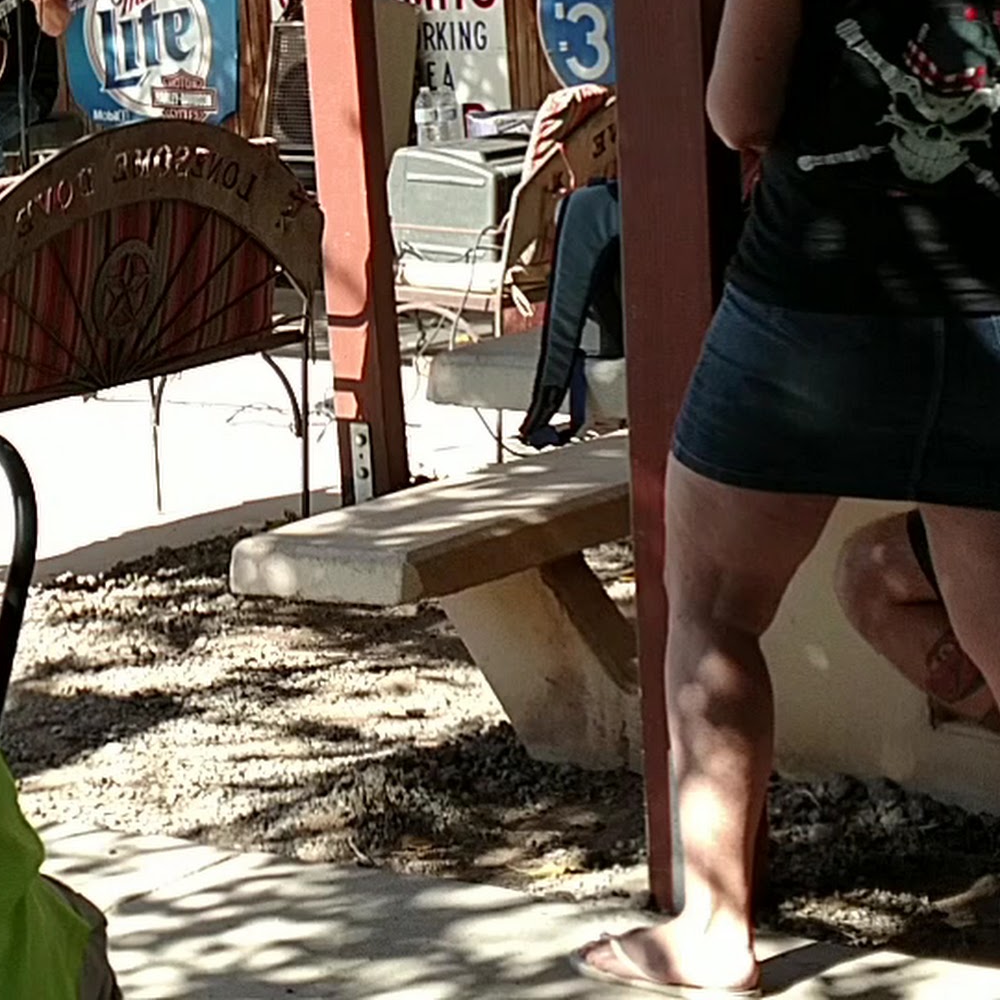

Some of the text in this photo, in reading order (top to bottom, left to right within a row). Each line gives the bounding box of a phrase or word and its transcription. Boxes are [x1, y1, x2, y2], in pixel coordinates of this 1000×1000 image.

[97, 0, 197, 89] Lite
[417, 20, 488, 51] RKING
[566, 2, 611, 80] 3
